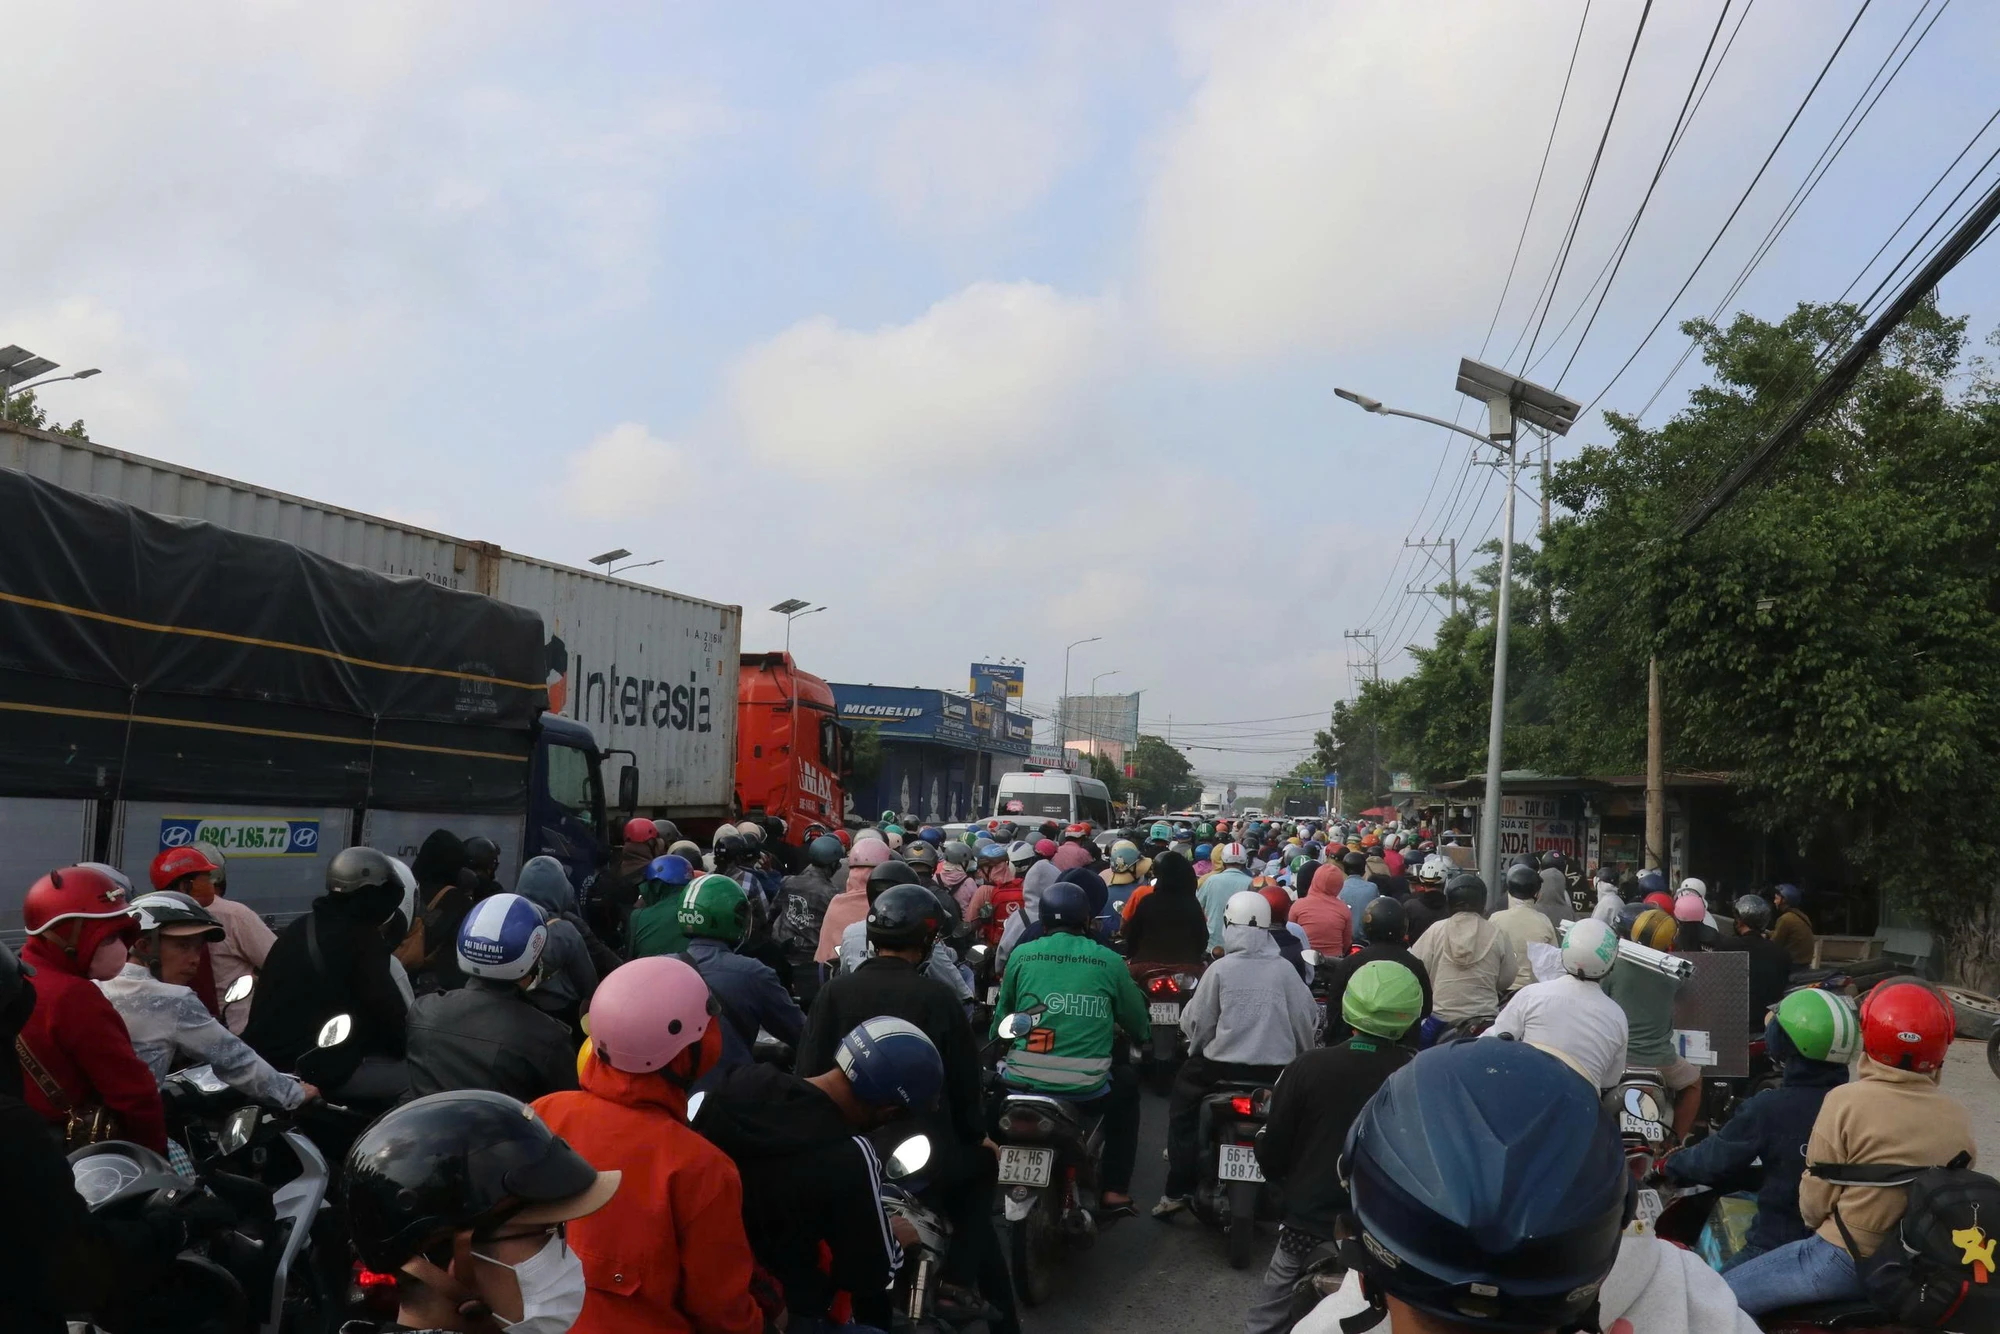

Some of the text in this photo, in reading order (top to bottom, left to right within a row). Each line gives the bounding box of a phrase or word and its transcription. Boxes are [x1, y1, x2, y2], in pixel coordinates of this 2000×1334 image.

[574, 655, 712, 733] Interasia
[843, 703, 923, 717] MICHELIN
[1524, 801, 1541, 816] TAY
[1542, 801, 1556, 816] GA
[1518, 821, 1530, 829] XE
[200, 826, 287, 848] 62C-185.77
[678, 911, 704, 924] Grab
[1044, 992, 1109, 1018] GHTK
[1007, 1150, 1044, 1166] 84-H6
[1227, 1148, 1257, 1164] 66-F
[1224, 1162, 1262, 1179] 188.78
